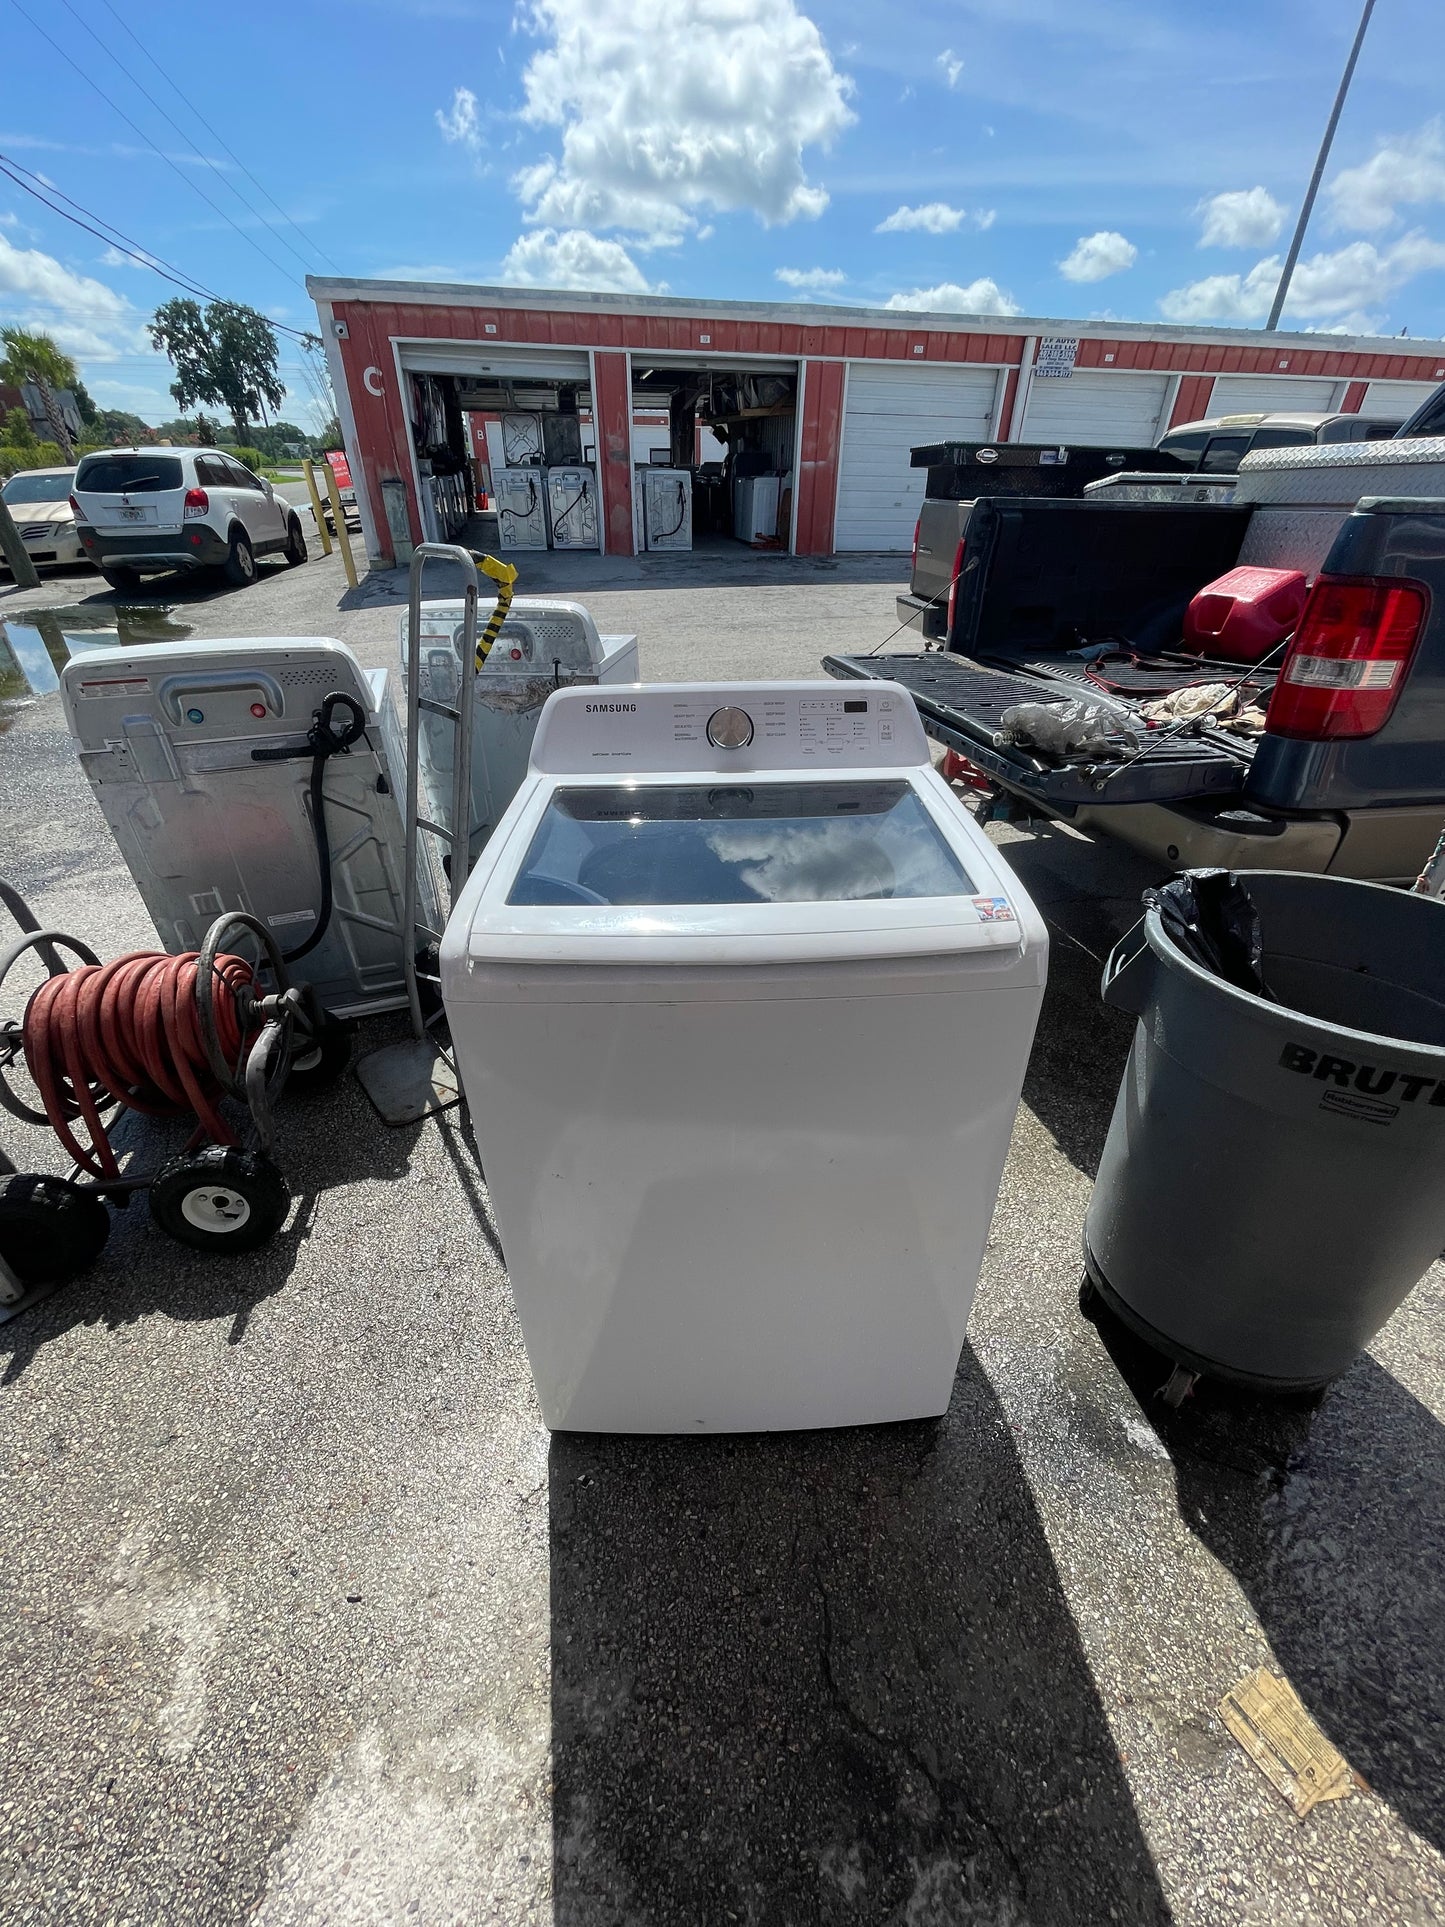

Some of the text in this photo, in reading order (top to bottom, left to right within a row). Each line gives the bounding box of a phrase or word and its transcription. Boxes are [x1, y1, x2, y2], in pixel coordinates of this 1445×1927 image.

[364, 366, 385, 396] C
[477, 430, 484, 439] B
[585, 704, 637, 712] SAMSUNG
